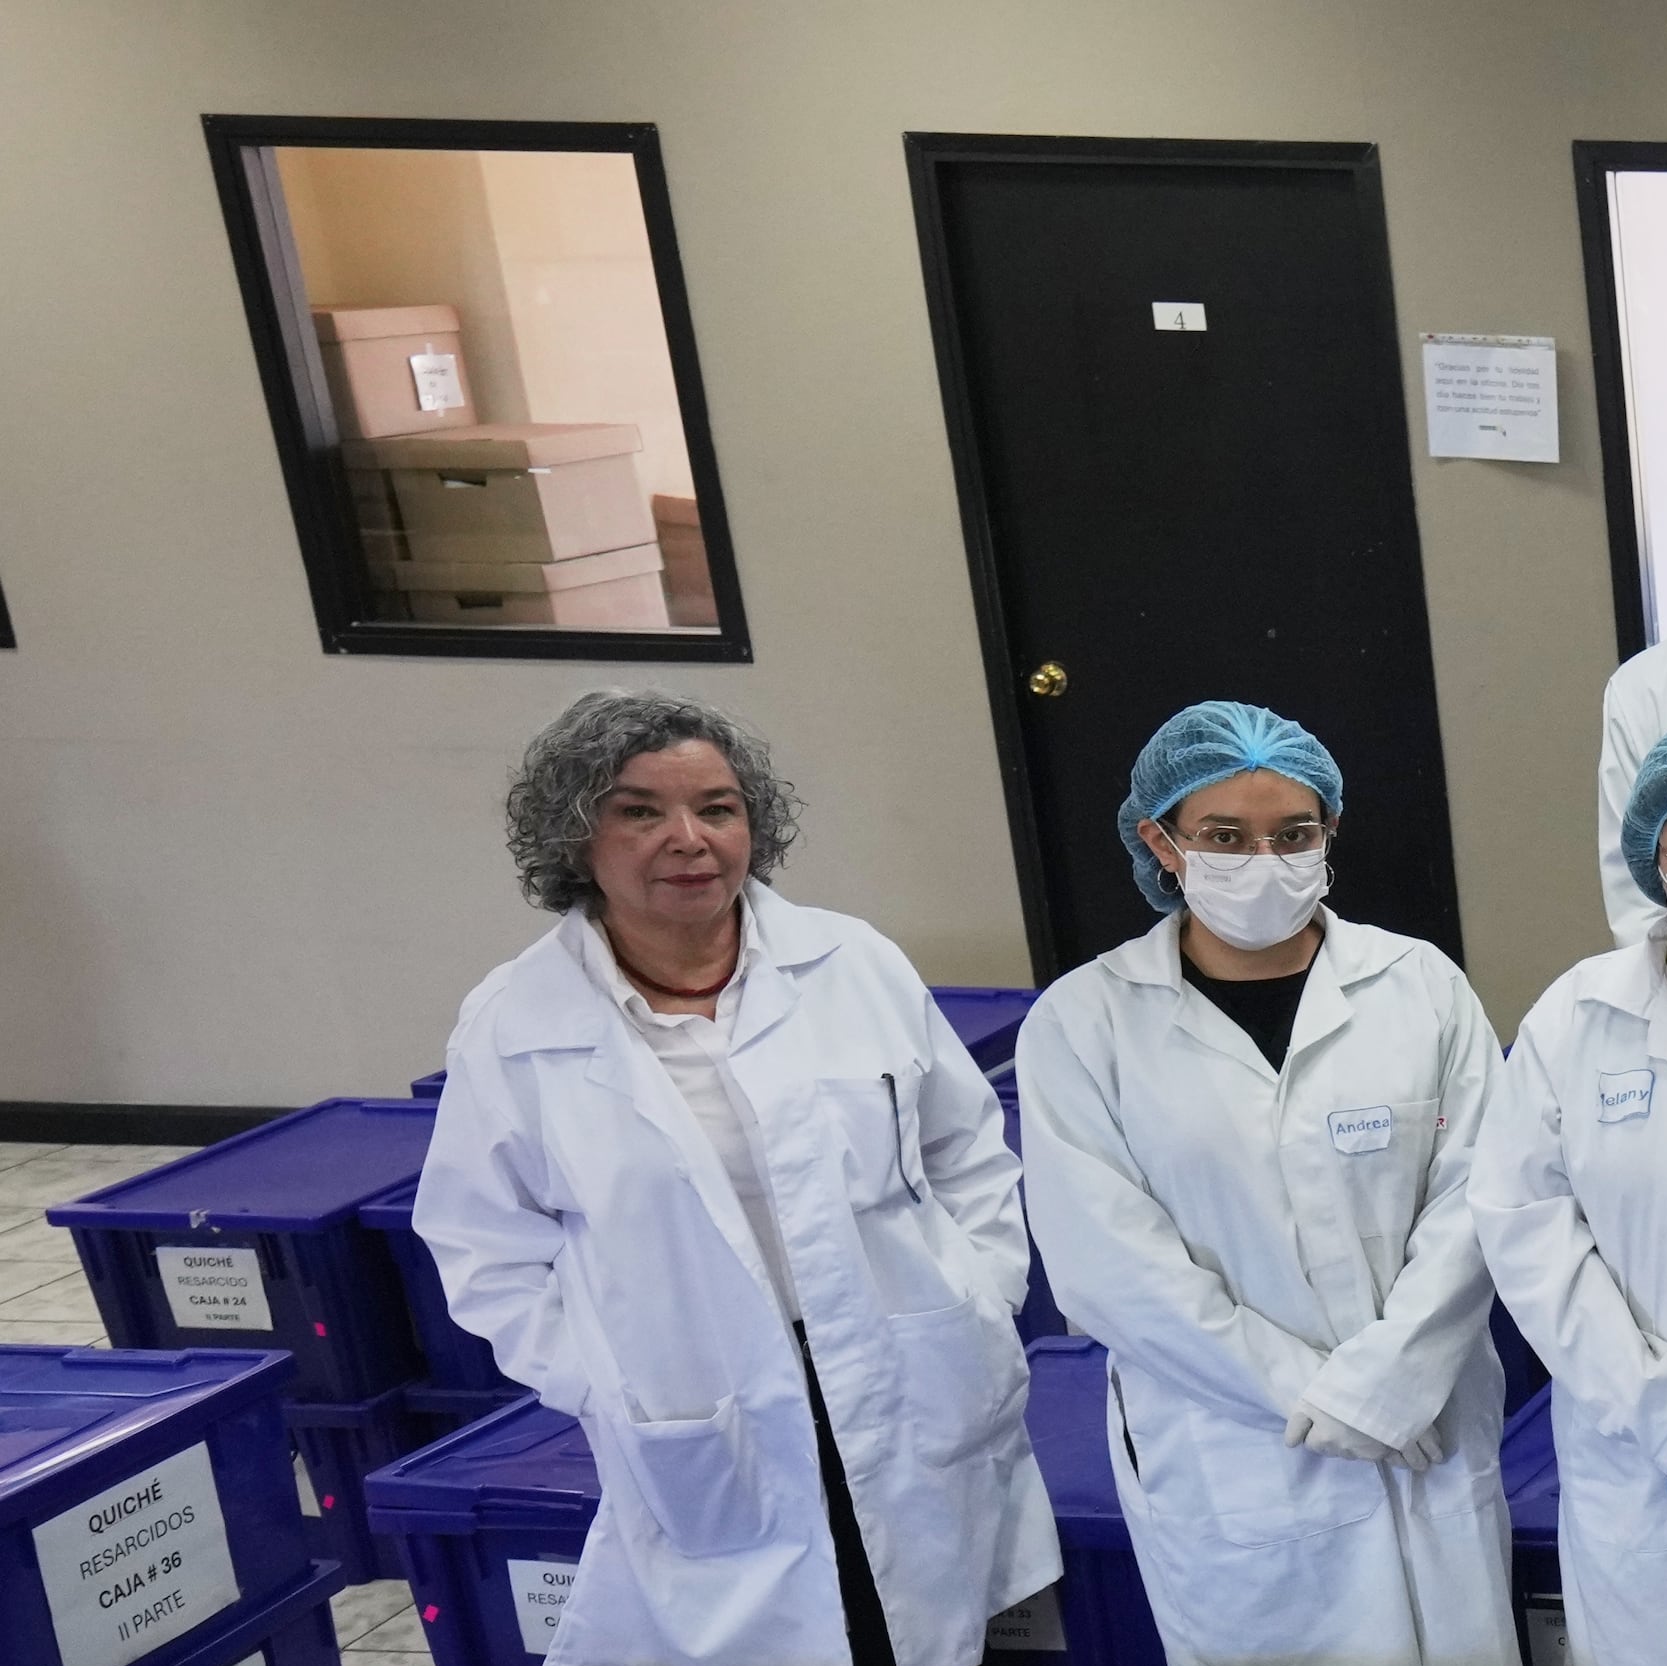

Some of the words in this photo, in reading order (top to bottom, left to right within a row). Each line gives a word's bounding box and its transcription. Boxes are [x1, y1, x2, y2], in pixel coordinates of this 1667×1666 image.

[1174, 311, 1186, 329] 4
[1336, 1119, 1390, 1135] Andrea
[183, 1254, 234, 1268] QUICHÉ
[189, 1296, 220, 1306] CAJA
[233, 1297, 247, 1306] 24
[88, 1478, 163, 1536] QUICHÉ
[79, 1504, 196, 1581] RESARCIDOS
[99, 1572, 146, 1609] CAJA
[147, 1563, 159, 1581] #
[160, 1551, 183, 1574] 36
[118, 1622, 130, 1641] II
[132, 1589, 186, 1632] PARTE
